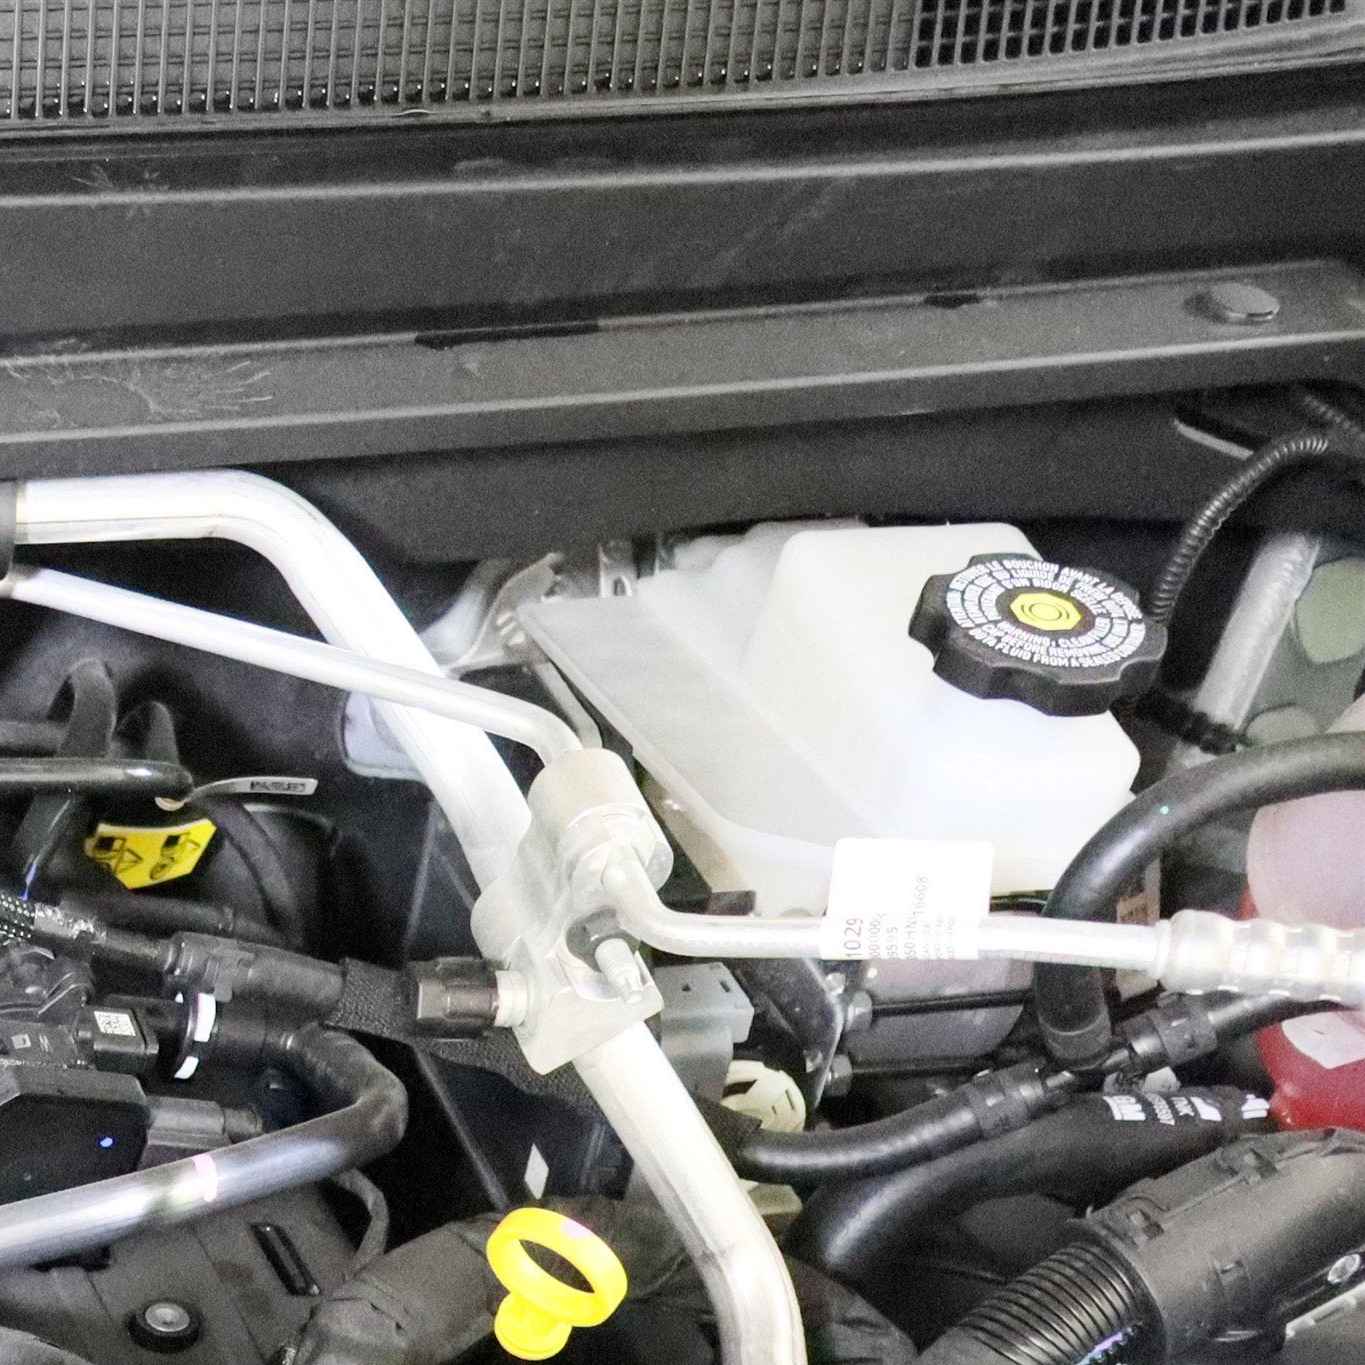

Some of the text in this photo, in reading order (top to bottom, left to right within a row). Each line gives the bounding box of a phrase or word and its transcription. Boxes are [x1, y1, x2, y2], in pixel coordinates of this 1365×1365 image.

[1003, 560, 1059, 572] BOUCHON
[1061, 566, 1103, 586] AVANT
[1096, 579, 1117, 595] LA
[1011, 569, 1055, 580] LIQUIDE
[1058, 574, 1075, 585] DE
[1033, 578, 1070, 592] BIDON
[995, 642, 1031, 660] FLUID
[1033, 654, 1069, 666] FROM
[1070, 658, 1080, 667] A
[1001, 635, 1047, 655] BEFORE
